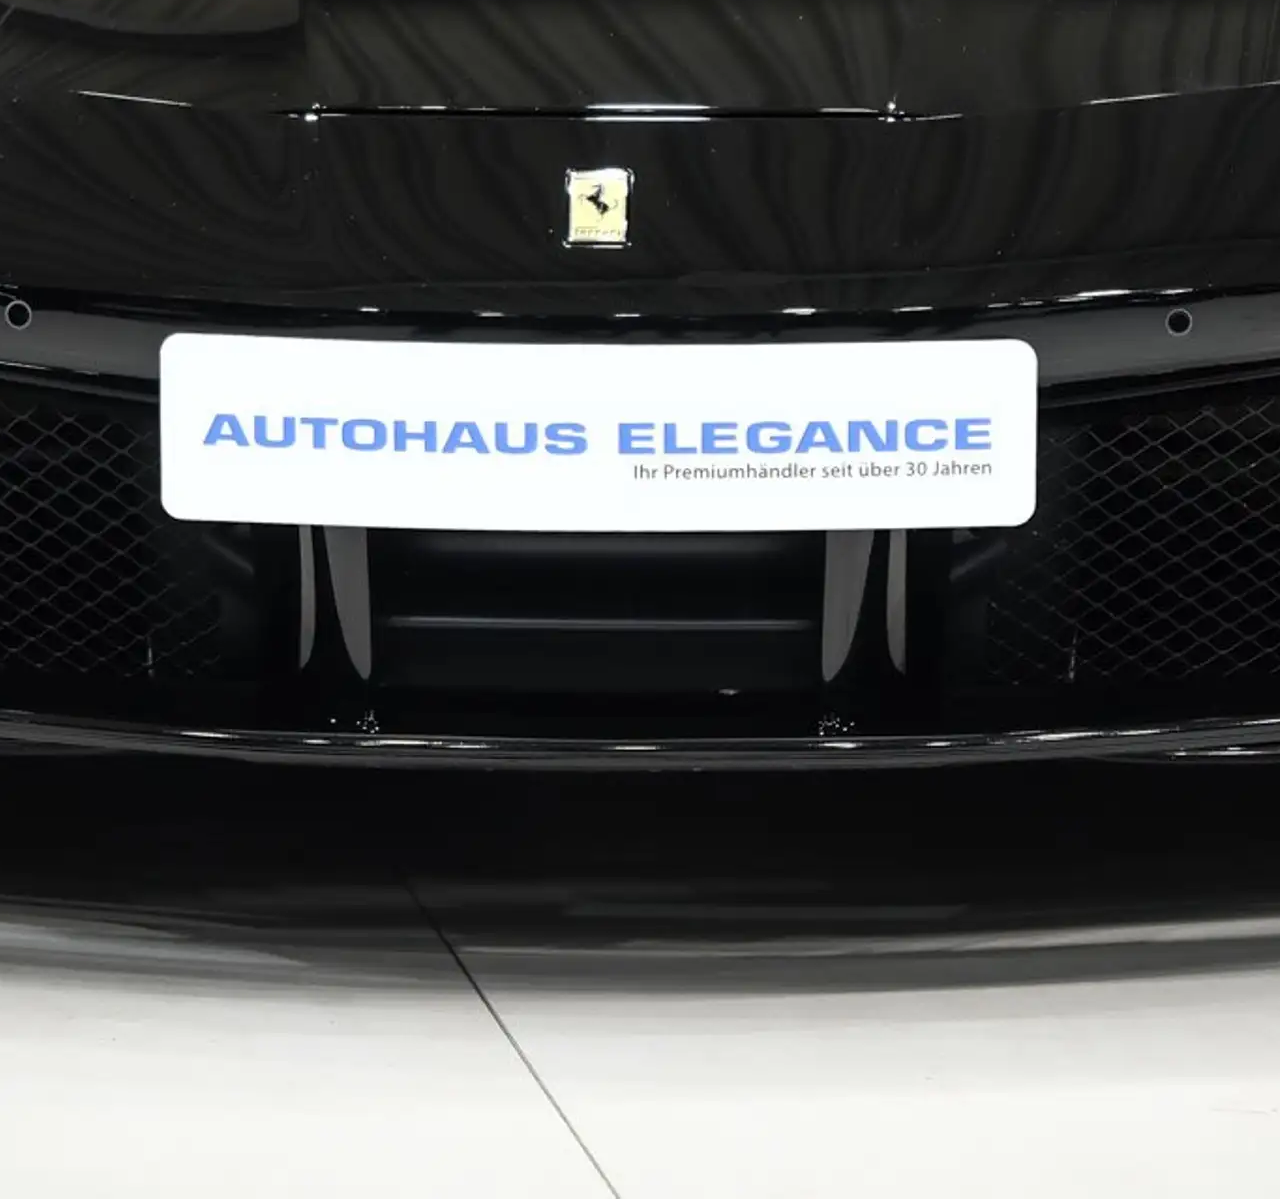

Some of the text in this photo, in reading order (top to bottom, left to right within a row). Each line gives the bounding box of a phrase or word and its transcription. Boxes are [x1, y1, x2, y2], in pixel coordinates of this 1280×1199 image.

[202, 413, 992, 456] AUTOHAUS ELEGANCE
[633, 460, 992, 481] Ihr Premiumhändler seit über 30 Jahren
